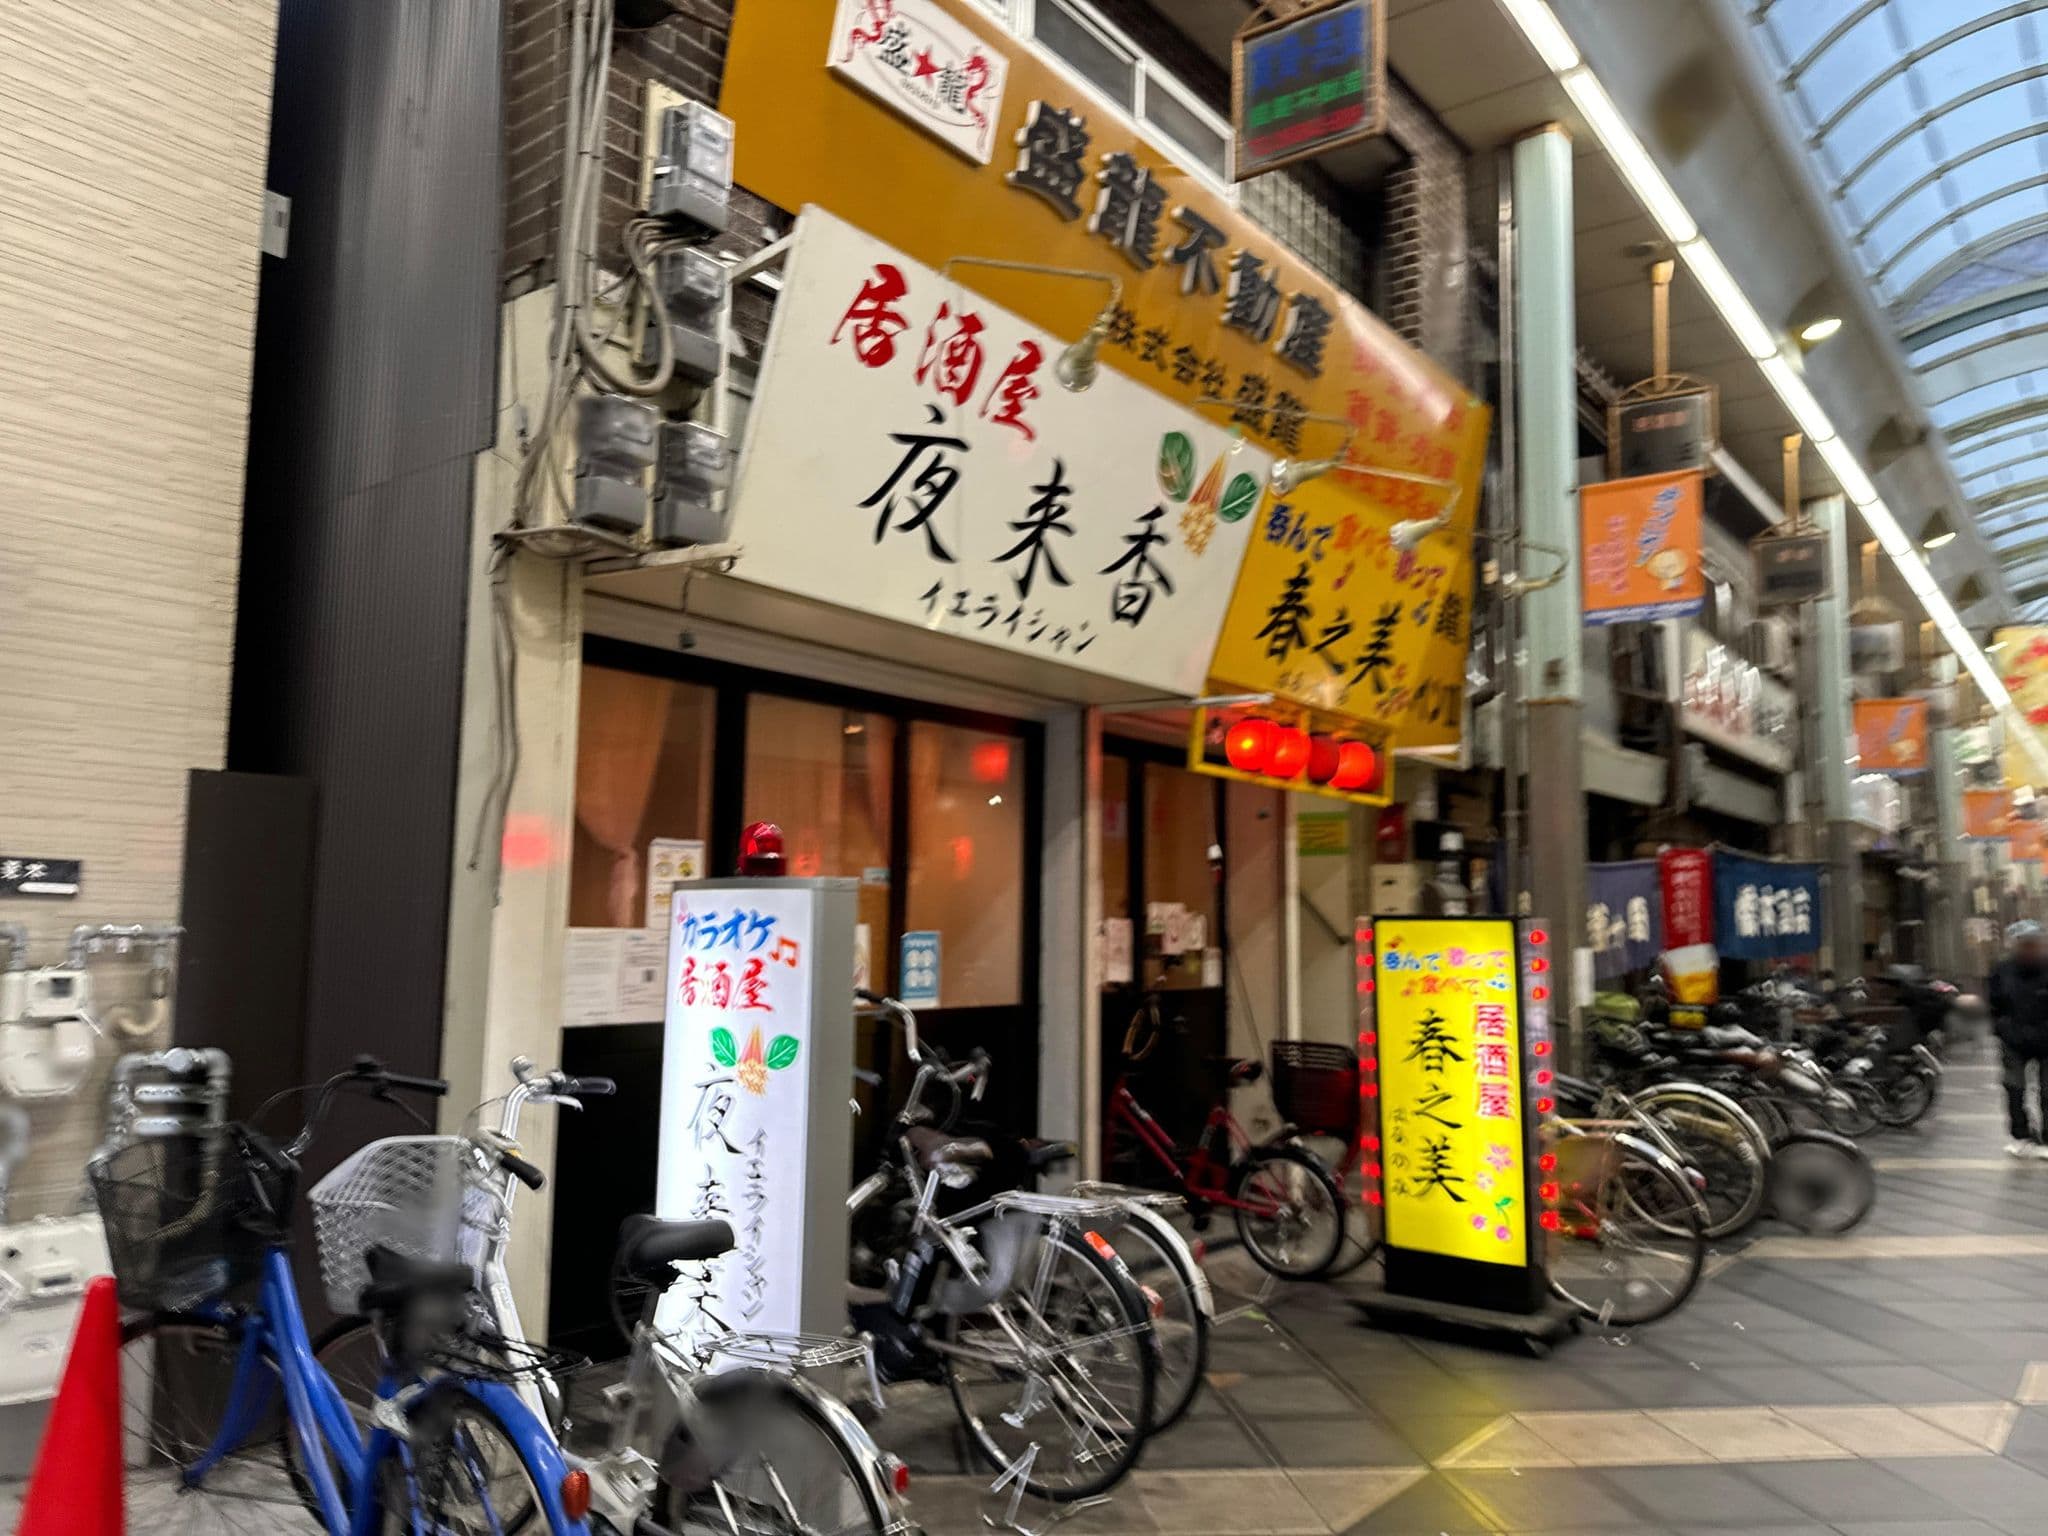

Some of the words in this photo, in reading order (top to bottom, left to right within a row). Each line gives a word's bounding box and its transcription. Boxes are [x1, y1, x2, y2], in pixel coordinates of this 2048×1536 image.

[831, 263, 1046, 441] 居酒屋
[857, 404, 1175, 628] 夜来香
[919, 579, 1098, 654] イエライシャン
[1255, 560, 1402, 695] 春之美
[679, 954, 774, 1012] 居酒屋
[682, 908, 777, 951] カラオケ
[1402, 1008, 1468, 1203] 春之美
[1474, 1003, 1514, 1119] 居酒屋
[742, 1127, 768, 1321] イエライシャン
